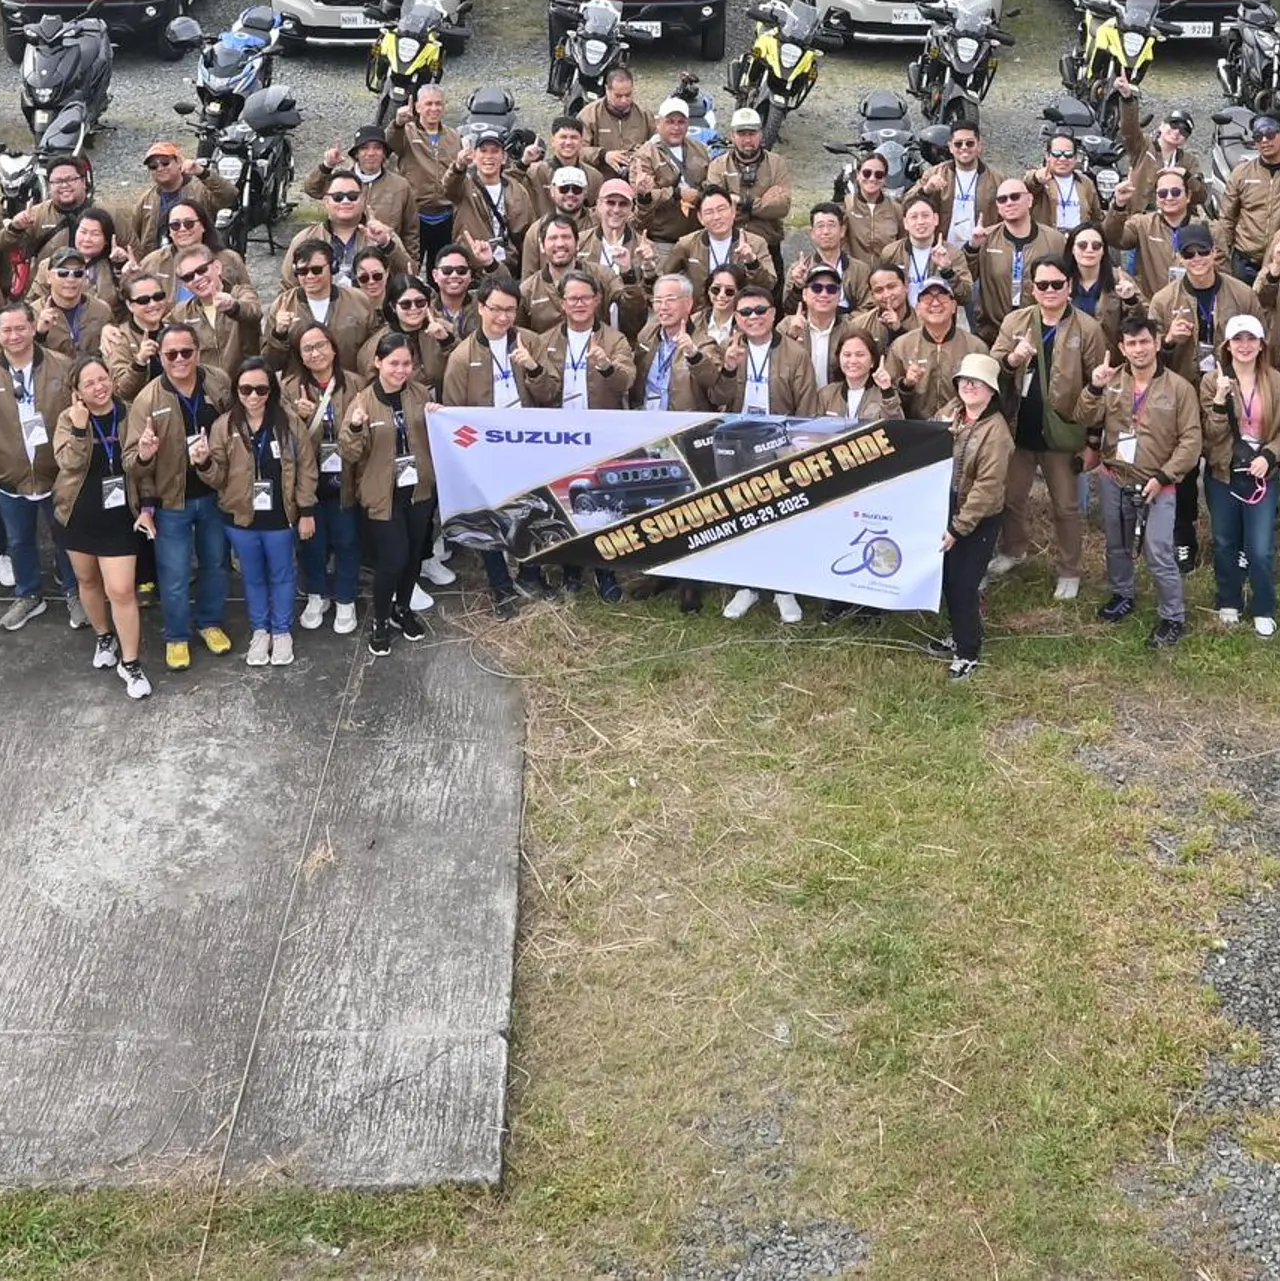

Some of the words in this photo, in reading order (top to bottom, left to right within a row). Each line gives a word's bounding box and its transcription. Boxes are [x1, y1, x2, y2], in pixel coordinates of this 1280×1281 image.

[485, 429, 592, 446] SUZUKI
[594, 524, 646, 561] ONE
[640, 492, 729, 544] SUZUKI
[724, 451, 834, 513] KICK-OFF
[831, 428, 896, 471] RIDE
[687, 519, 738, 550] JANUARY
[740, 506, 778, 529] 28-29,
[777, 492, 810, 515] 2025
